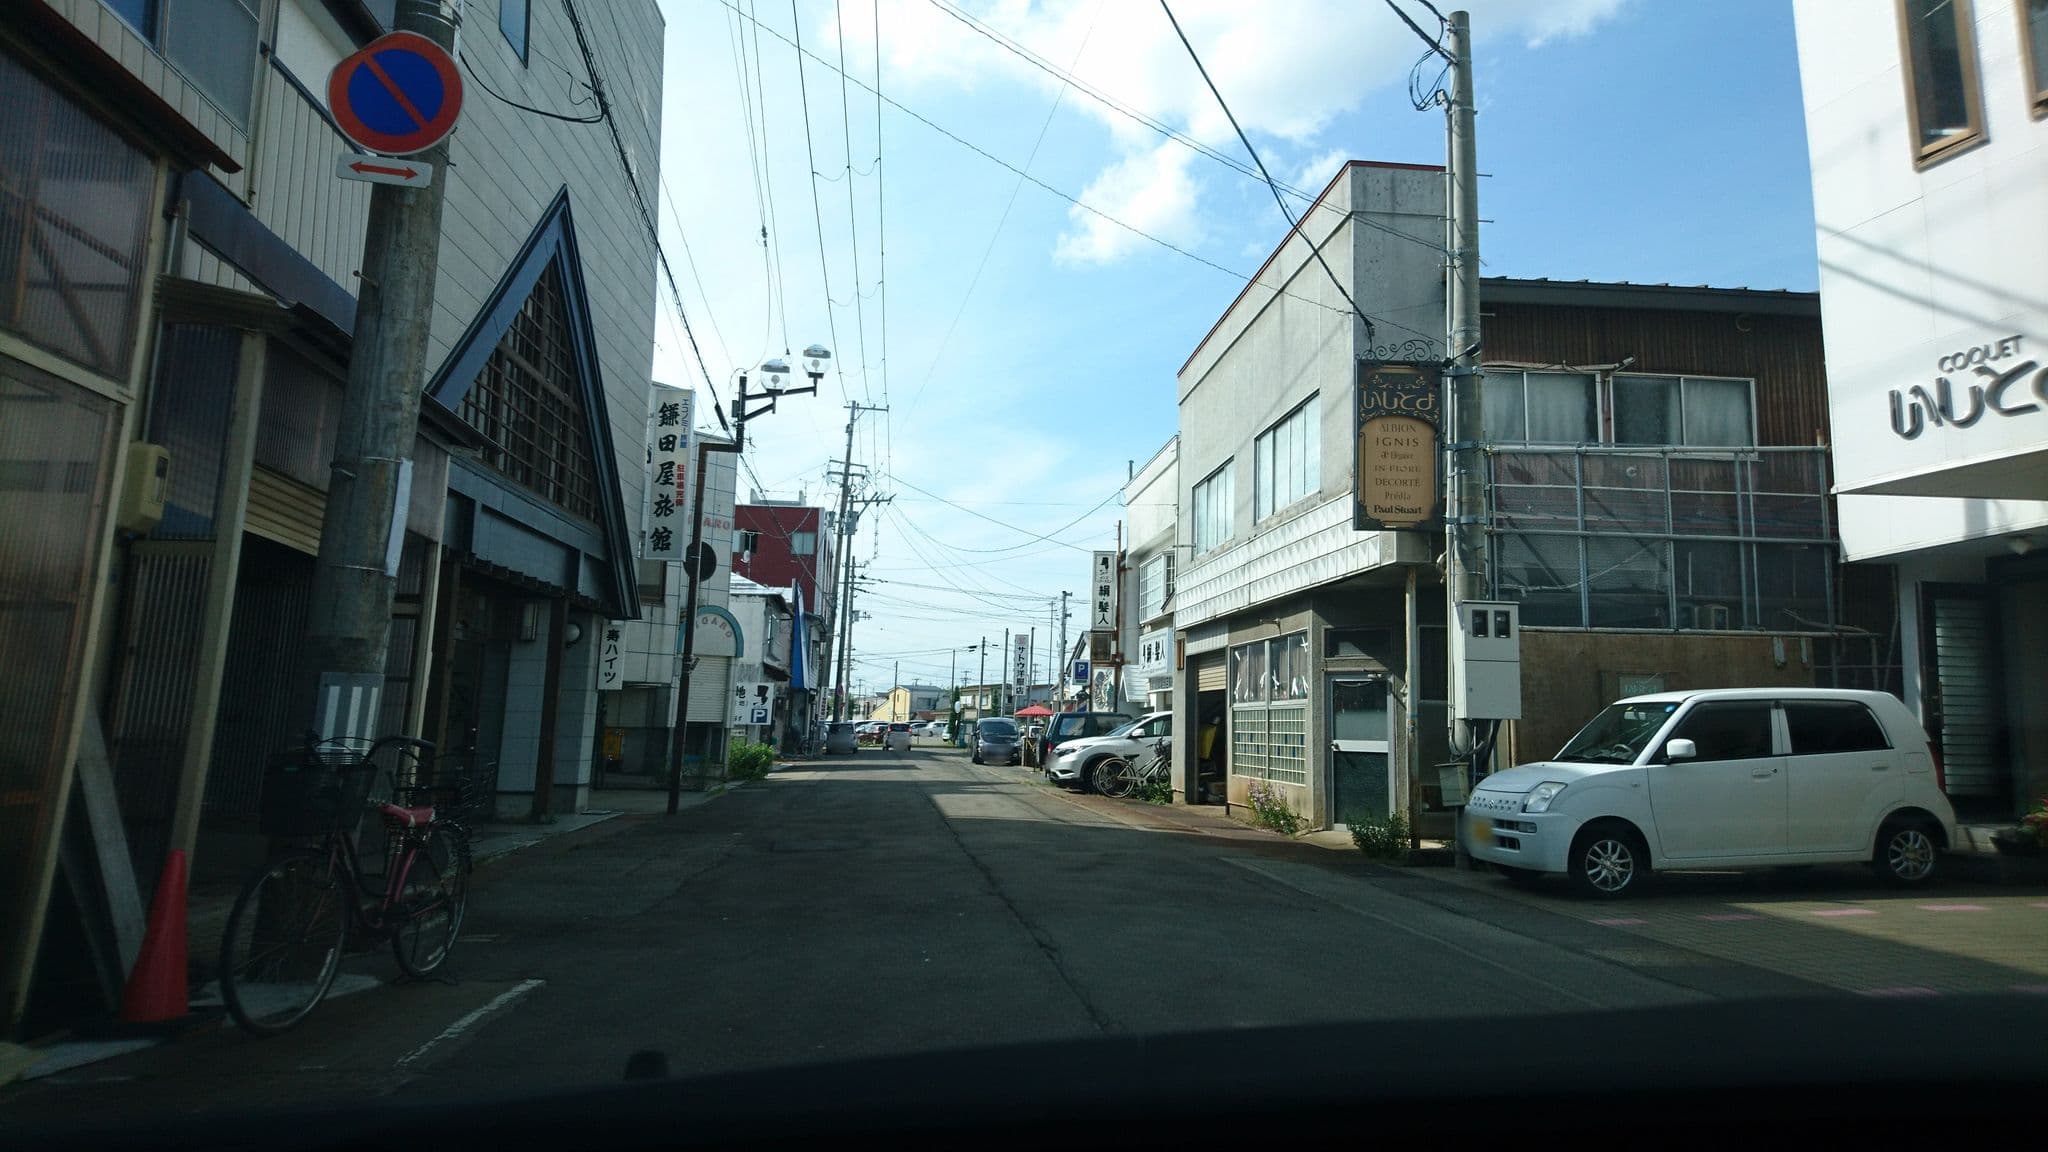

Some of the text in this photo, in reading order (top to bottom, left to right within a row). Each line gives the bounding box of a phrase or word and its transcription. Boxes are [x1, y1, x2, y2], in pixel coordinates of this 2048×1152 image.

[1938, 334, 2024, 374] COQUET
[1379, 423, 1417, 433] ALBION
[1375, 436, 1420, 448] IGNIS
[650, 401, 680, 552] 鎌田屋旅館
[1373, 504, 1422, 515] Paul Stuart
[752, 709, 766, 723] P
